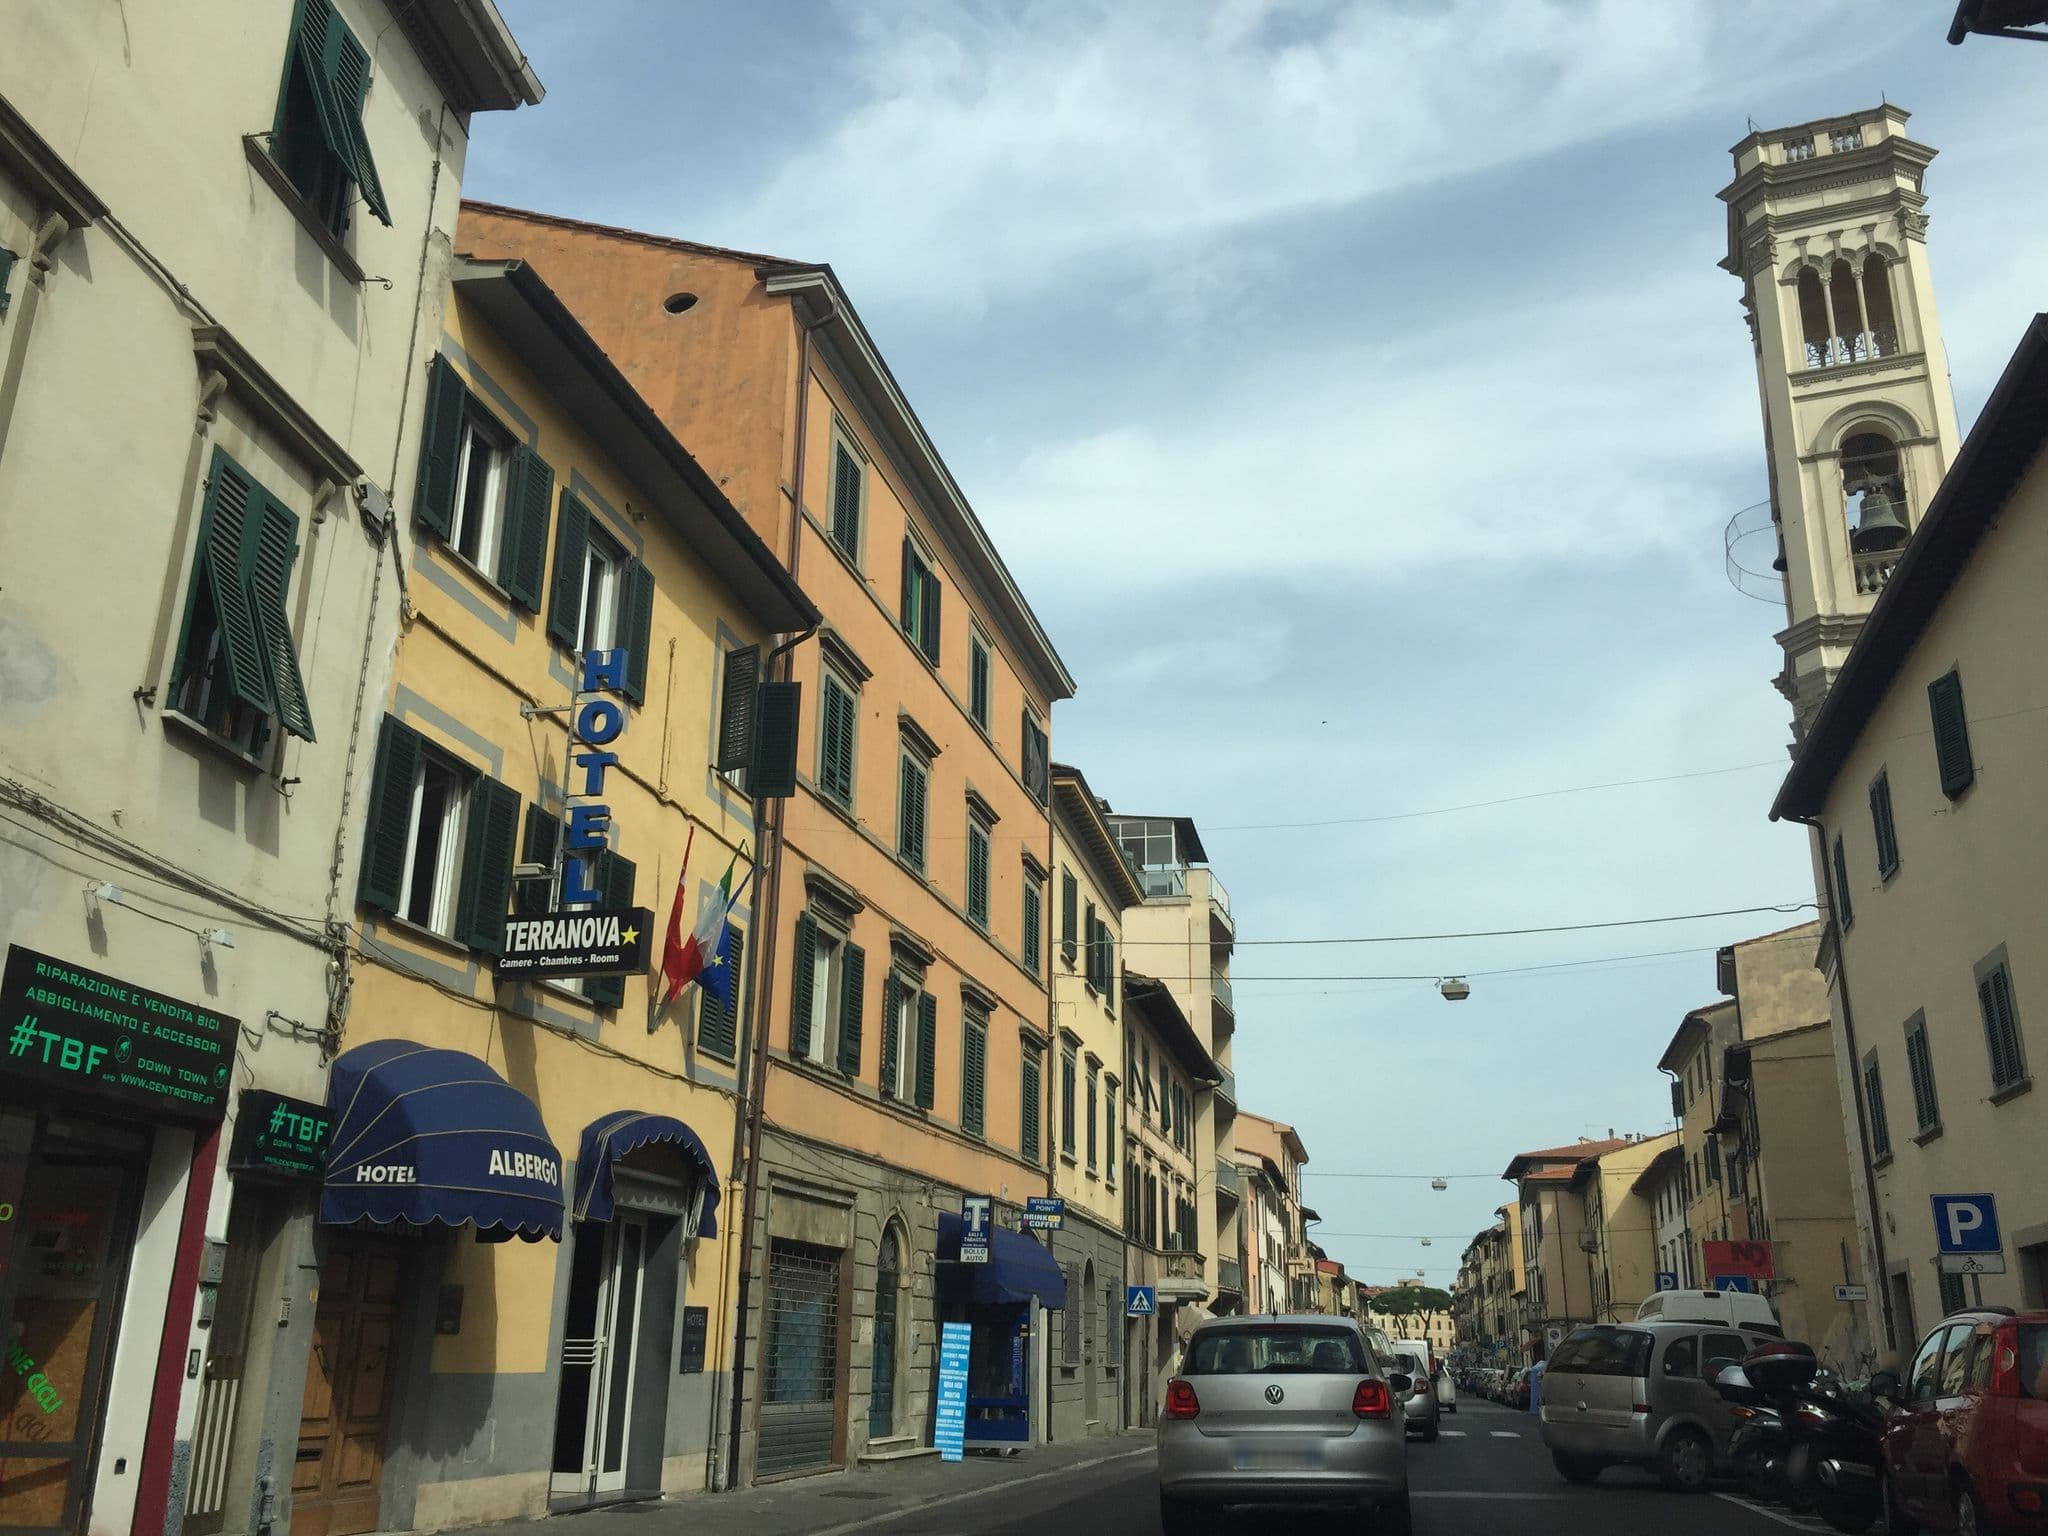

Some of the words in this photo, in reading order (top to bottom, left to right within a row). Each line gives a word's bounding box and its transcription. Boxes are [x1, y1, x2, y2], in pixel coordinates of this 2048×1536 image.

[565, 648, 628, 903] HOTEL
[505, 916, 620, 952] TERRANOVA
[499, 958, 533, 968] Camere
[539, 955, 583, 966] Chambres
[590, 953, 620, 963] Rooms
[36, 962, 128, 1002] RIPARAZIONE
[131, 993, 140, 1006] E
[143, 997, 193, 1023] VENDITA
[197, 1014, 220, 1031] BICI
[25, 986, 138, 1030] ABBIGLIAMENTO
[142, 1021, 150, 1034] E
[153, 1026, 221, 1055] ACCESSORI
[9, 1015, 108, 1074] #TBF
[120, 1073, 216, 1105] WWW.CENTROTBF.IT
[137, 1057, 171, 1076] DOWN
[178, 1068, 208, 1086] TOWN
[270, 1102, 329, 1143] #TBF
[356, 1165, 417, 1183] HOTEL
[489, 1149, 558, 1187] ALBERGO
[965, 1198, 990, 1232] T
[1029, 1220, 1060, 1228] COFFEE
[1946, 1203, 1983, 1245] P
